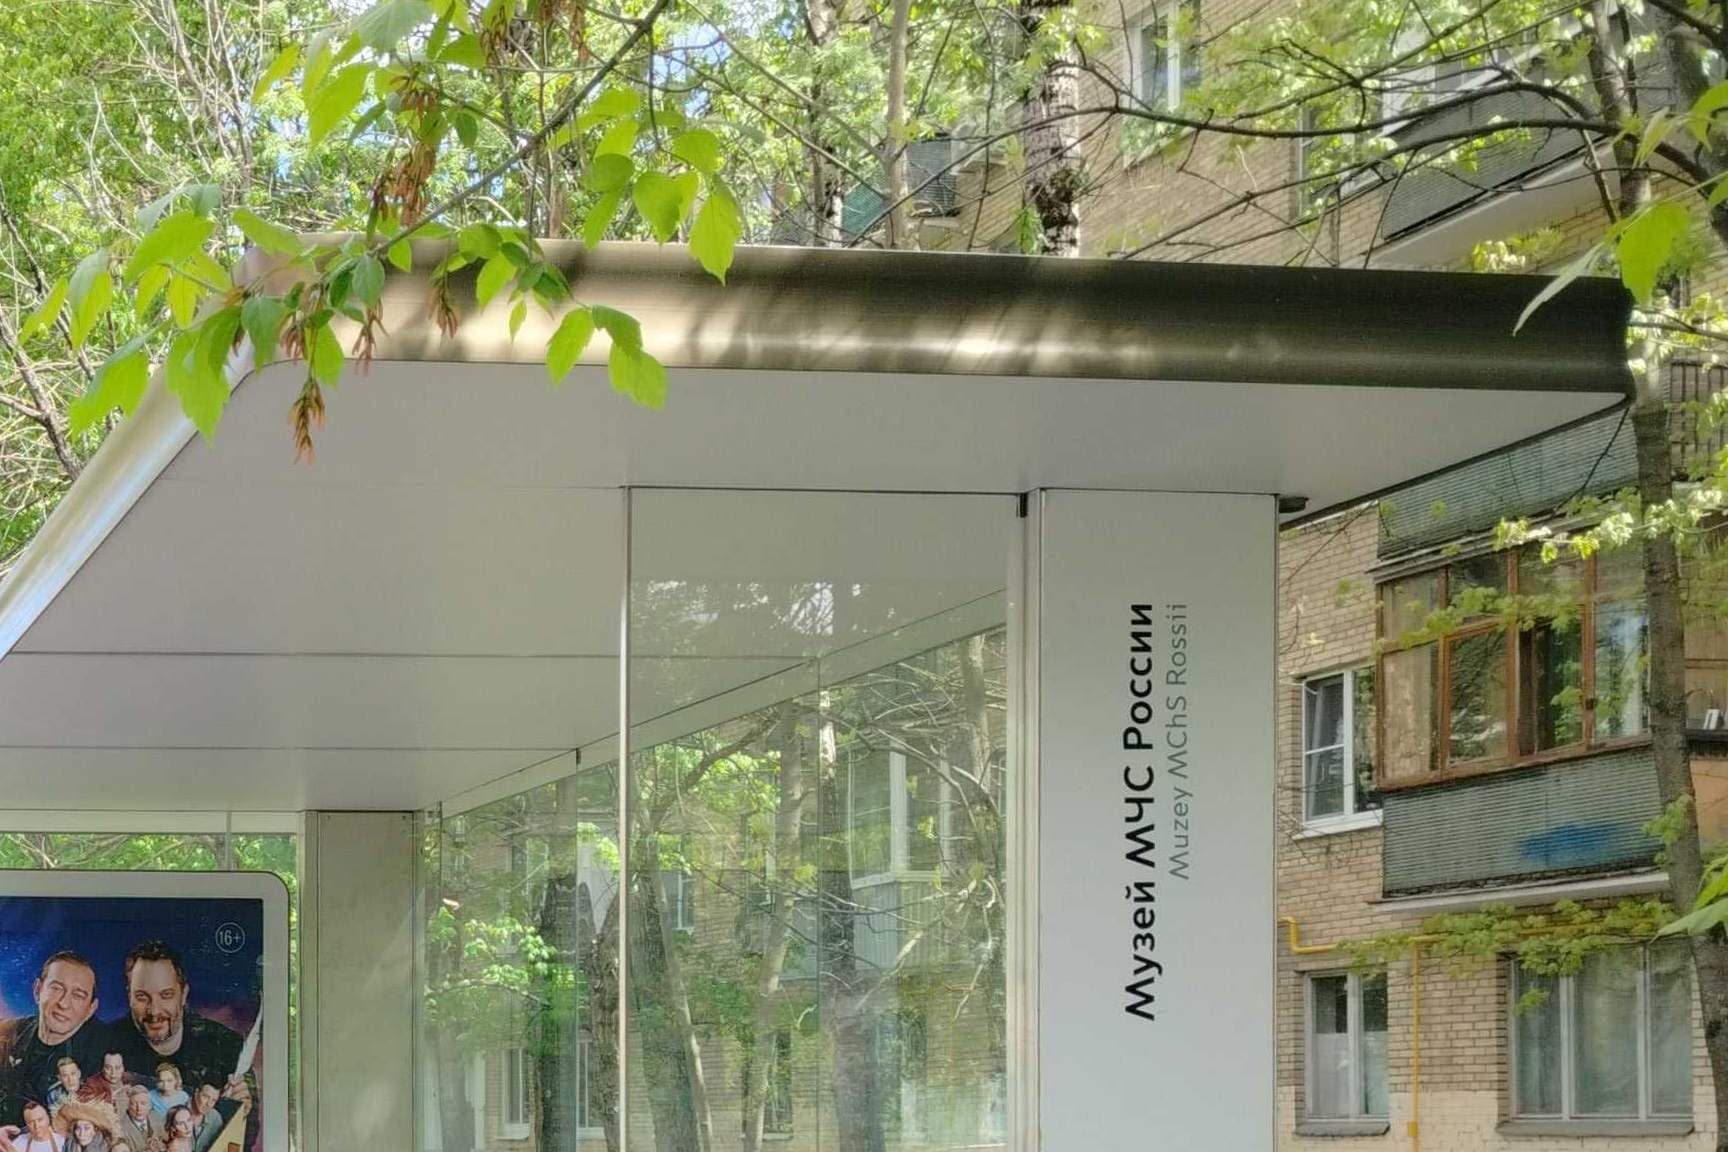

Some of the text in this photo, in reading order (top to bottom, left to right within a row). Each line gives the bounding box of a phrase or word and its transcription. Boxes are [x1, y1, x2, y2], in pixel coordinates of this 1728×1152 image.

[1122, 604, 1163, 1022] Музей МЧС России
[1165, 603, 1194, 881] Muzey MChS Rossii
[219, 929, 242, 946] 16+
